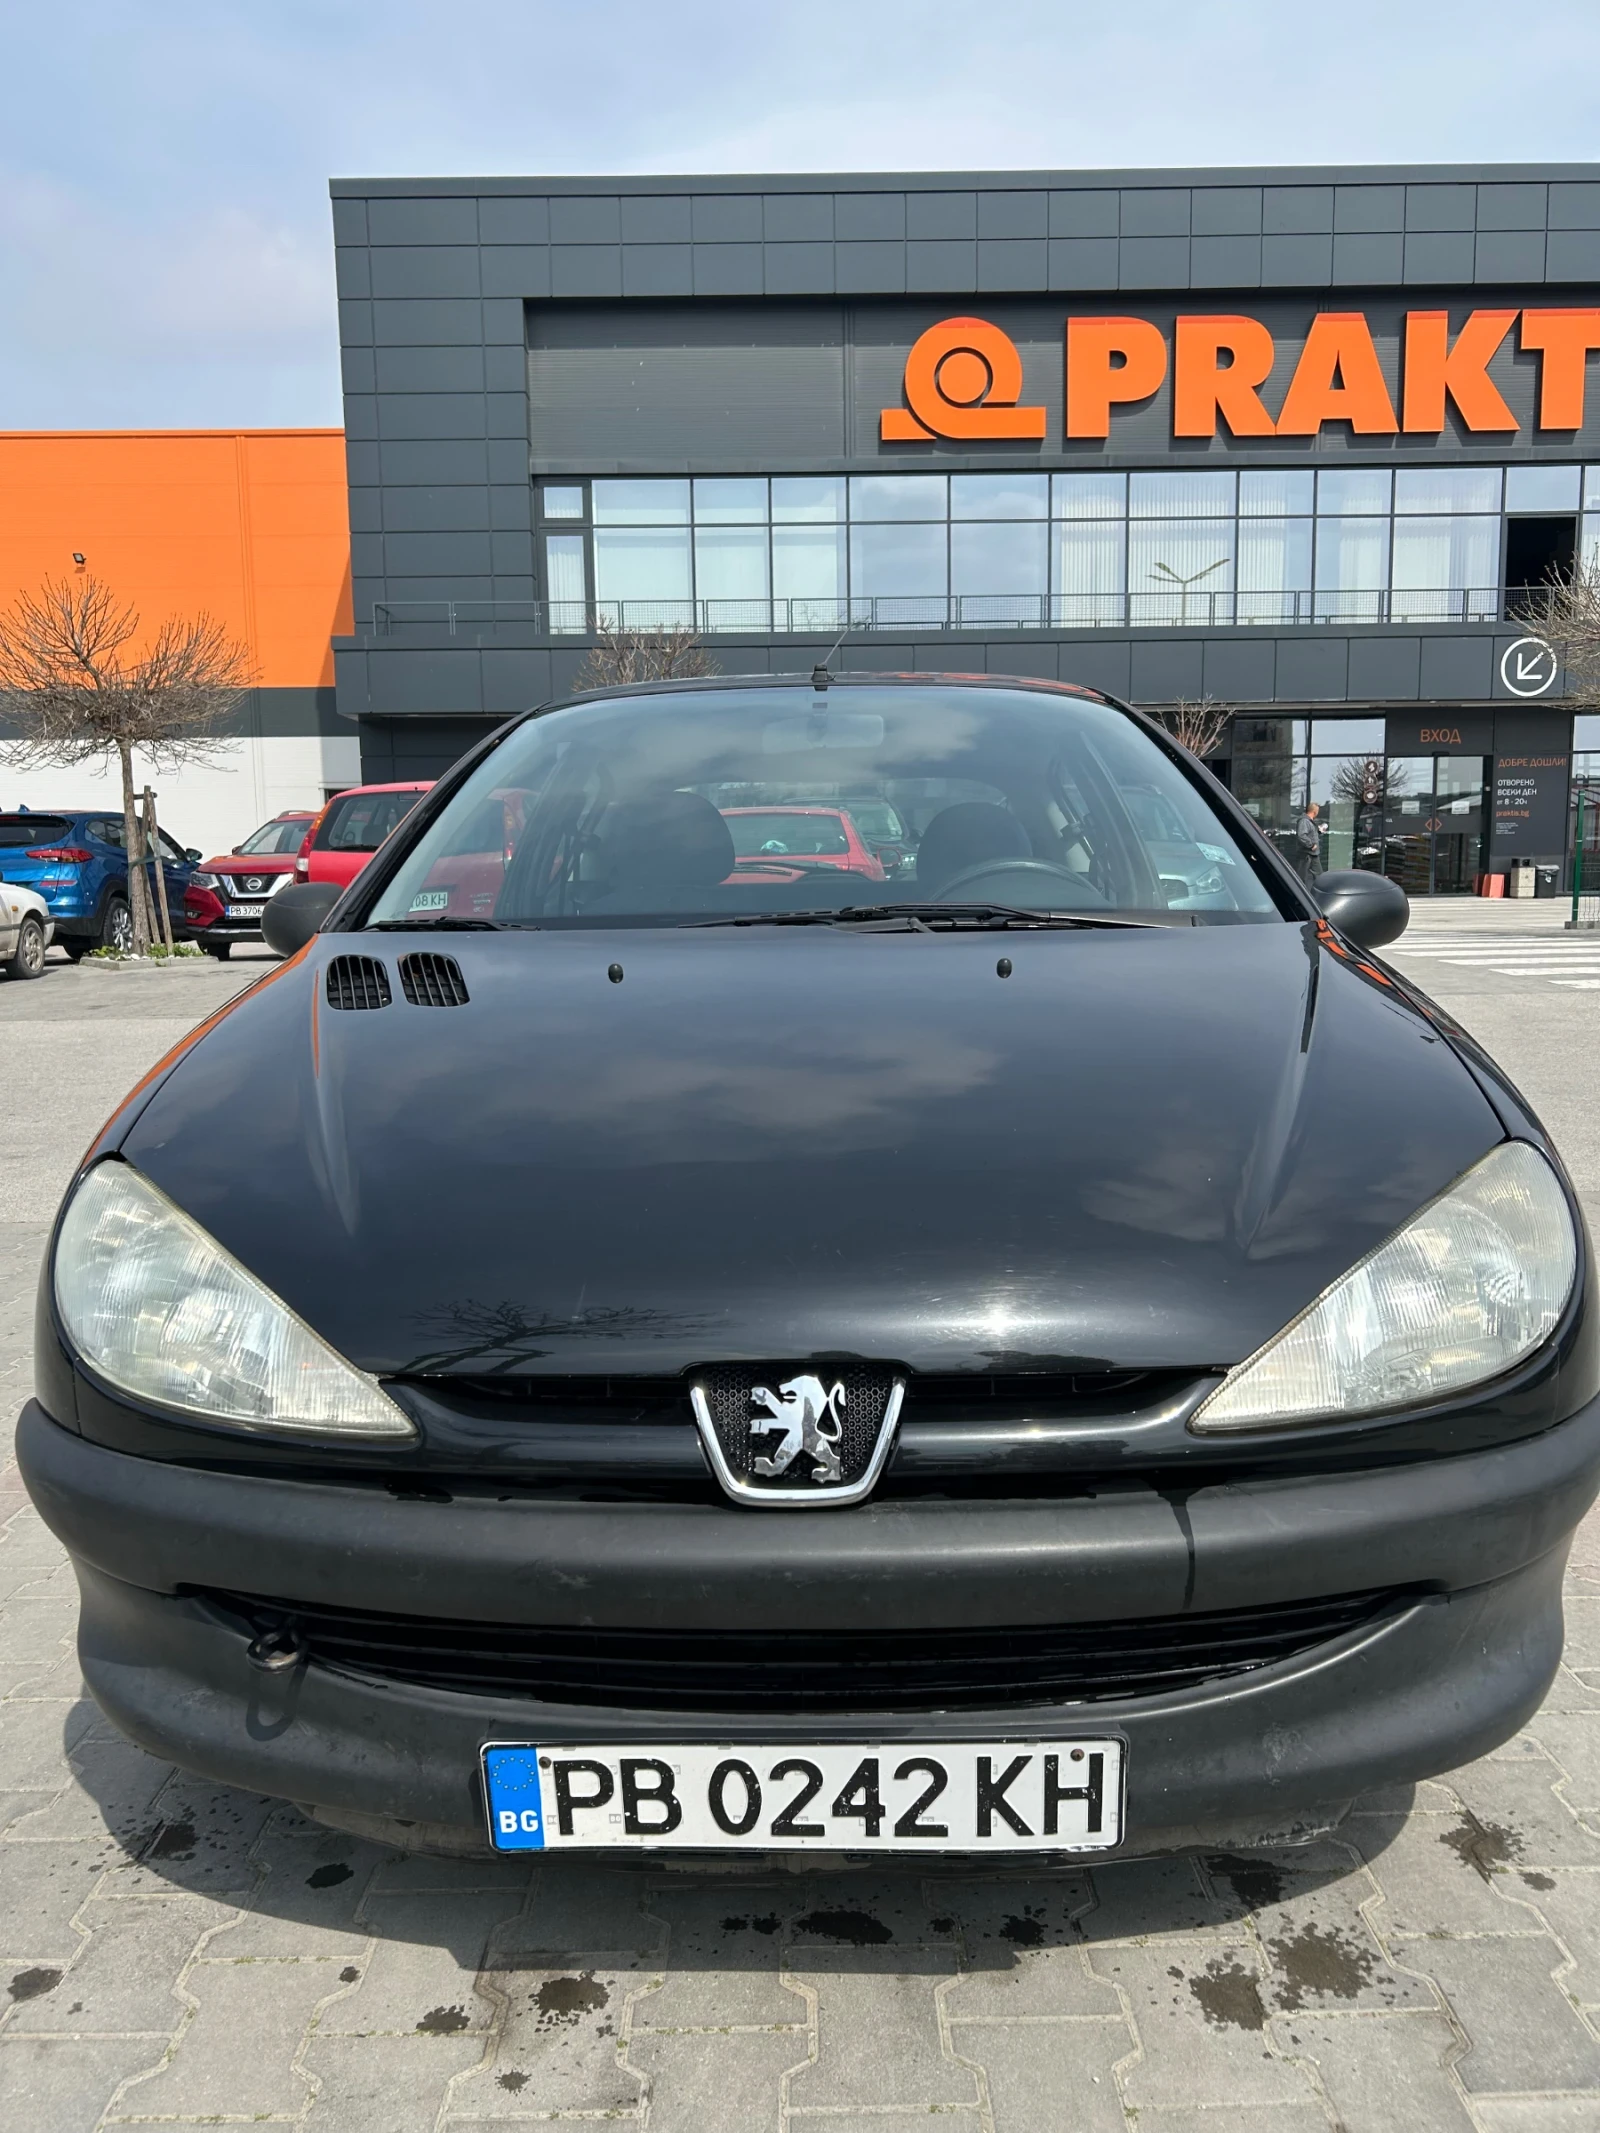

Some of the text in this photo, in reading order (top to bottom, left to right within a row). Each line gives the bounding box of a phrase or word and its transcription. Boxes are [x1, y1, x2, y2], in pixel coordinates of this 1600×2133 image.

[1066, 307, 1600, 438] PRAKT
[1420, 729, 1461, 744] ВХОД
[1498, 757, 1567, 768] ДОБРЕ ДОШЛИ!
[1497, 779, 1535, 787] ОТВОРЕНО
[1522, 788, 1537, 796] ДЕН
[430, 893, 447, 906] KH
[230, 906, 242, 915] PB
[553, 1752, 1104, 1837] PB 0242 KH
[500, 1810, 539, 1834] BG
